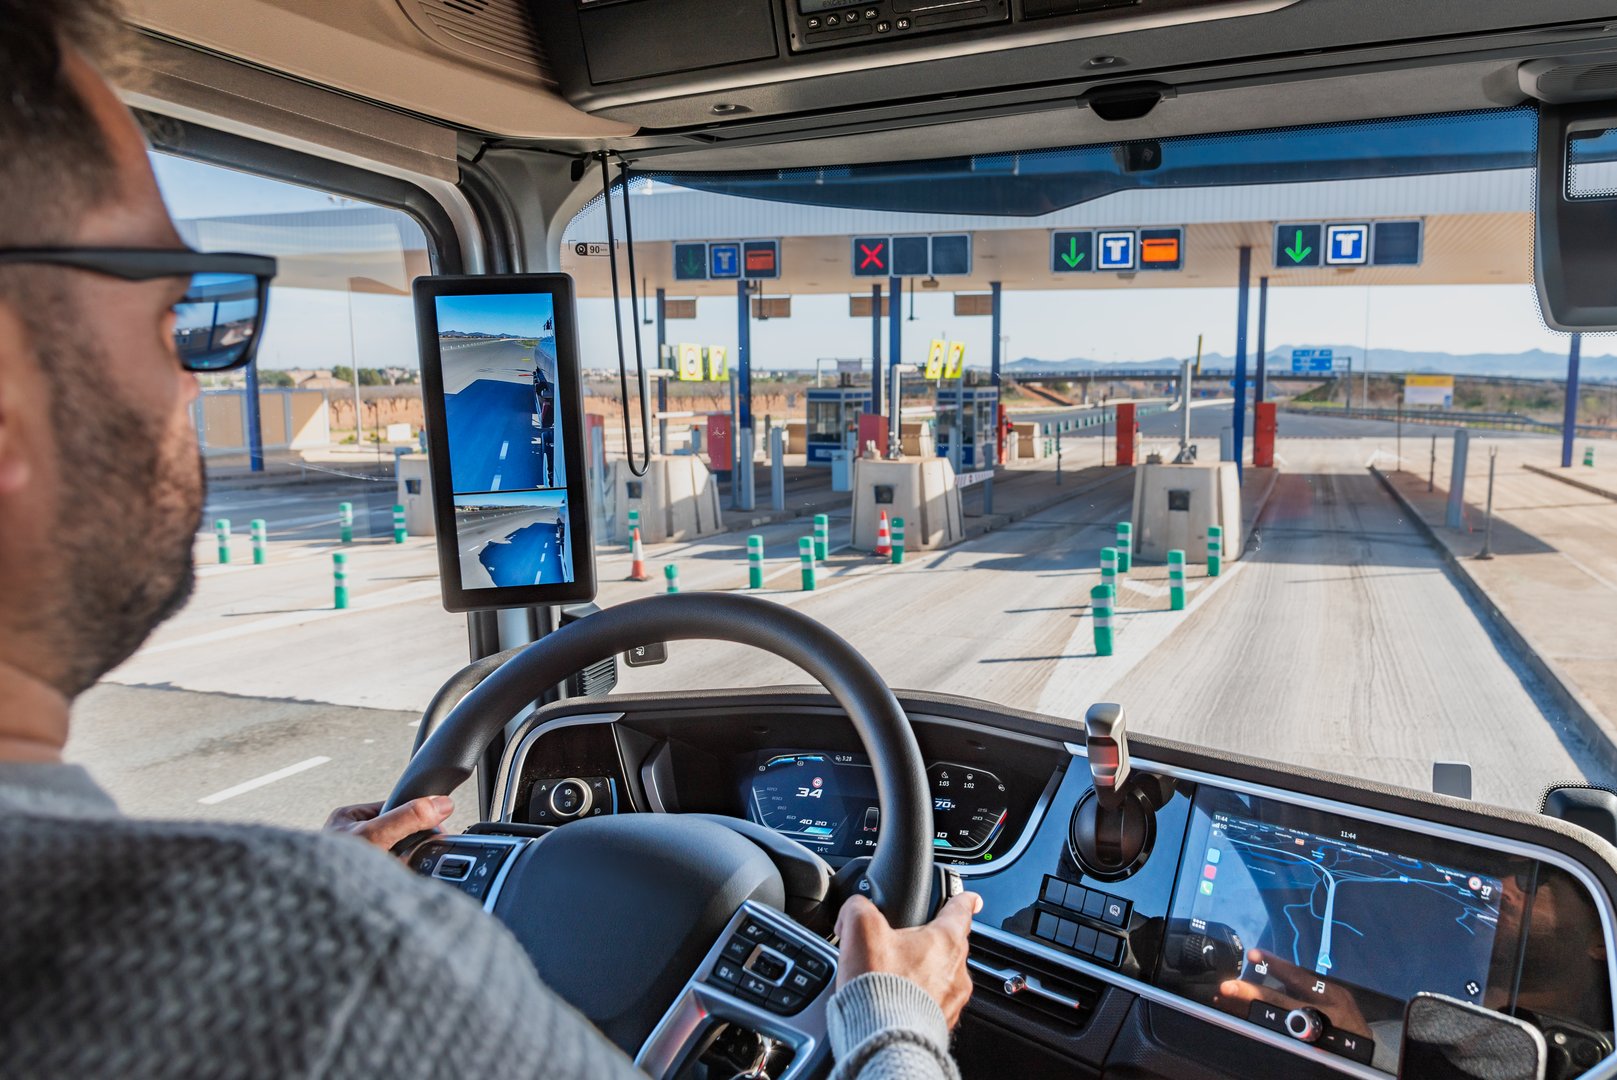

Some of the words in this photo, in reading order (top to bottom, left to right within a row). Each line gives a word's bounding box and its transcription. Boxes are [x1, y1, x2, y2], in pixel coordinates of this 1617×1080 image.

[1335, 232, 1359, 255] T
[589, 245, 600, 254] 90
[1105, 239, 1128, 261] T
[717, 252, 730, 271] T
[795, 787, 823, 799] 34
[1215, 814, 1228, 823] 11:44
[1340, 830, 1357, 840] 11:44
[1481, 885, 1492, 896] 37
